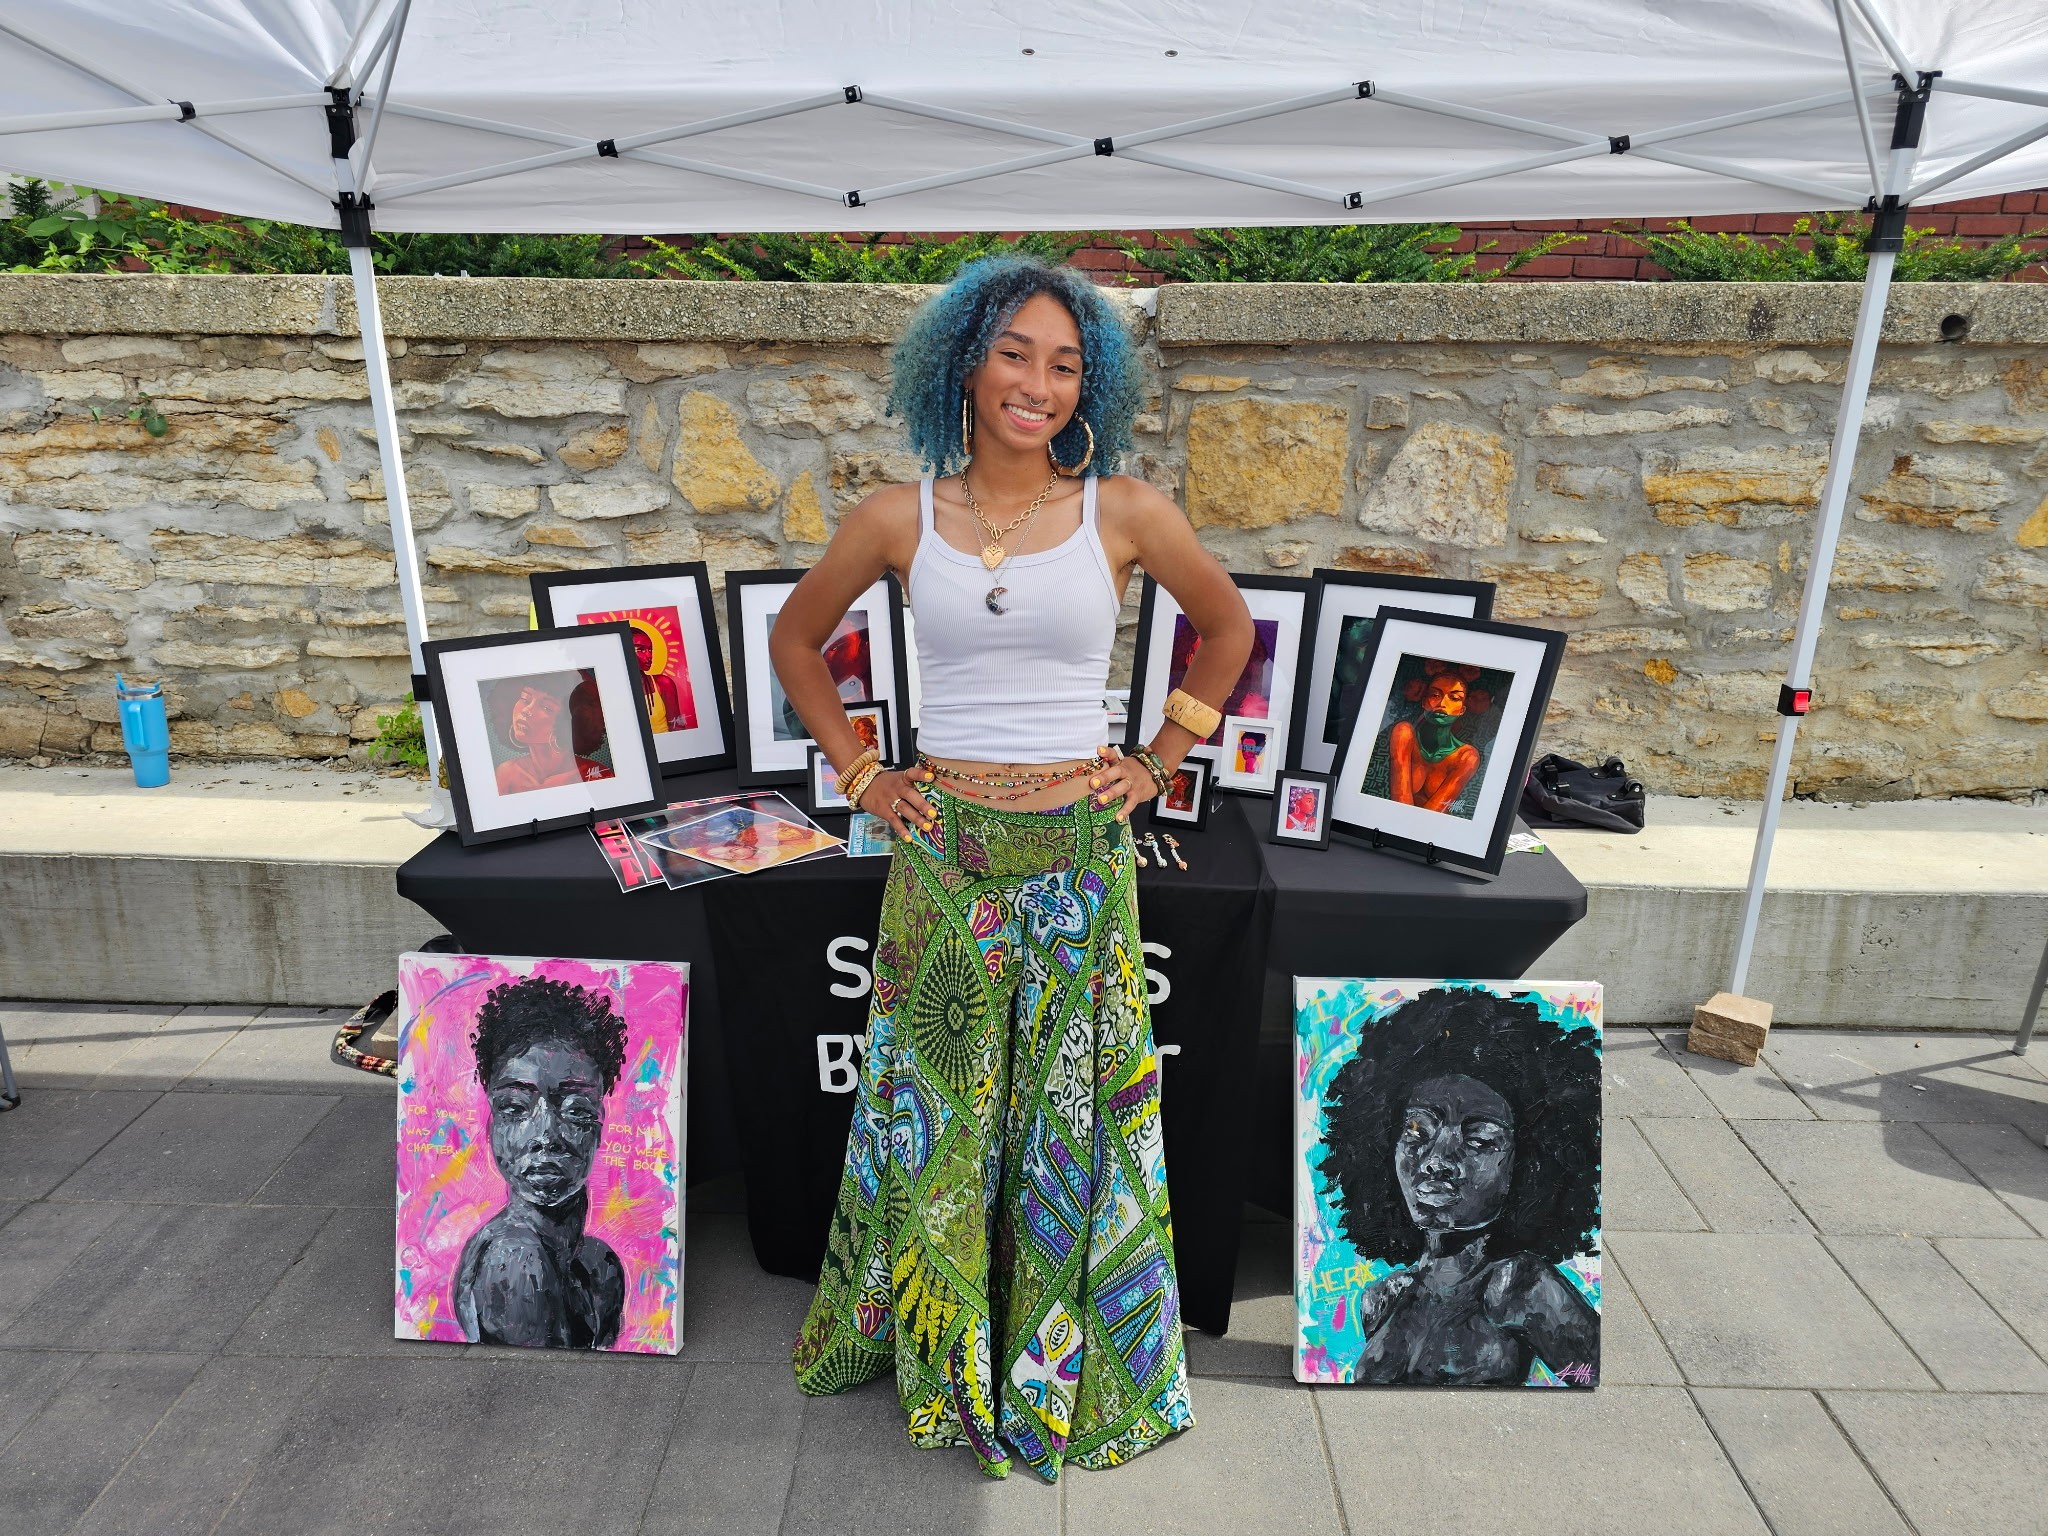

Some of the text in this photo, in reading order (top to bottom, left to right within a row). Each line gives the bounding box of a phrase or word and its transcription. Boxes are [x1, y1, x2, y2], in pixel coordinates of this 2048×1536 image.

[407, 1104, 428, 1115] FOR
[466, 1109, 477, 1120] I
[405, 1126, 445, 1137] WAS A
[608, 1123, 632, 1135] FOR
[603, 1140, 669, 1158] YOU WERE
[601, 1155, 626, 1167] THE
